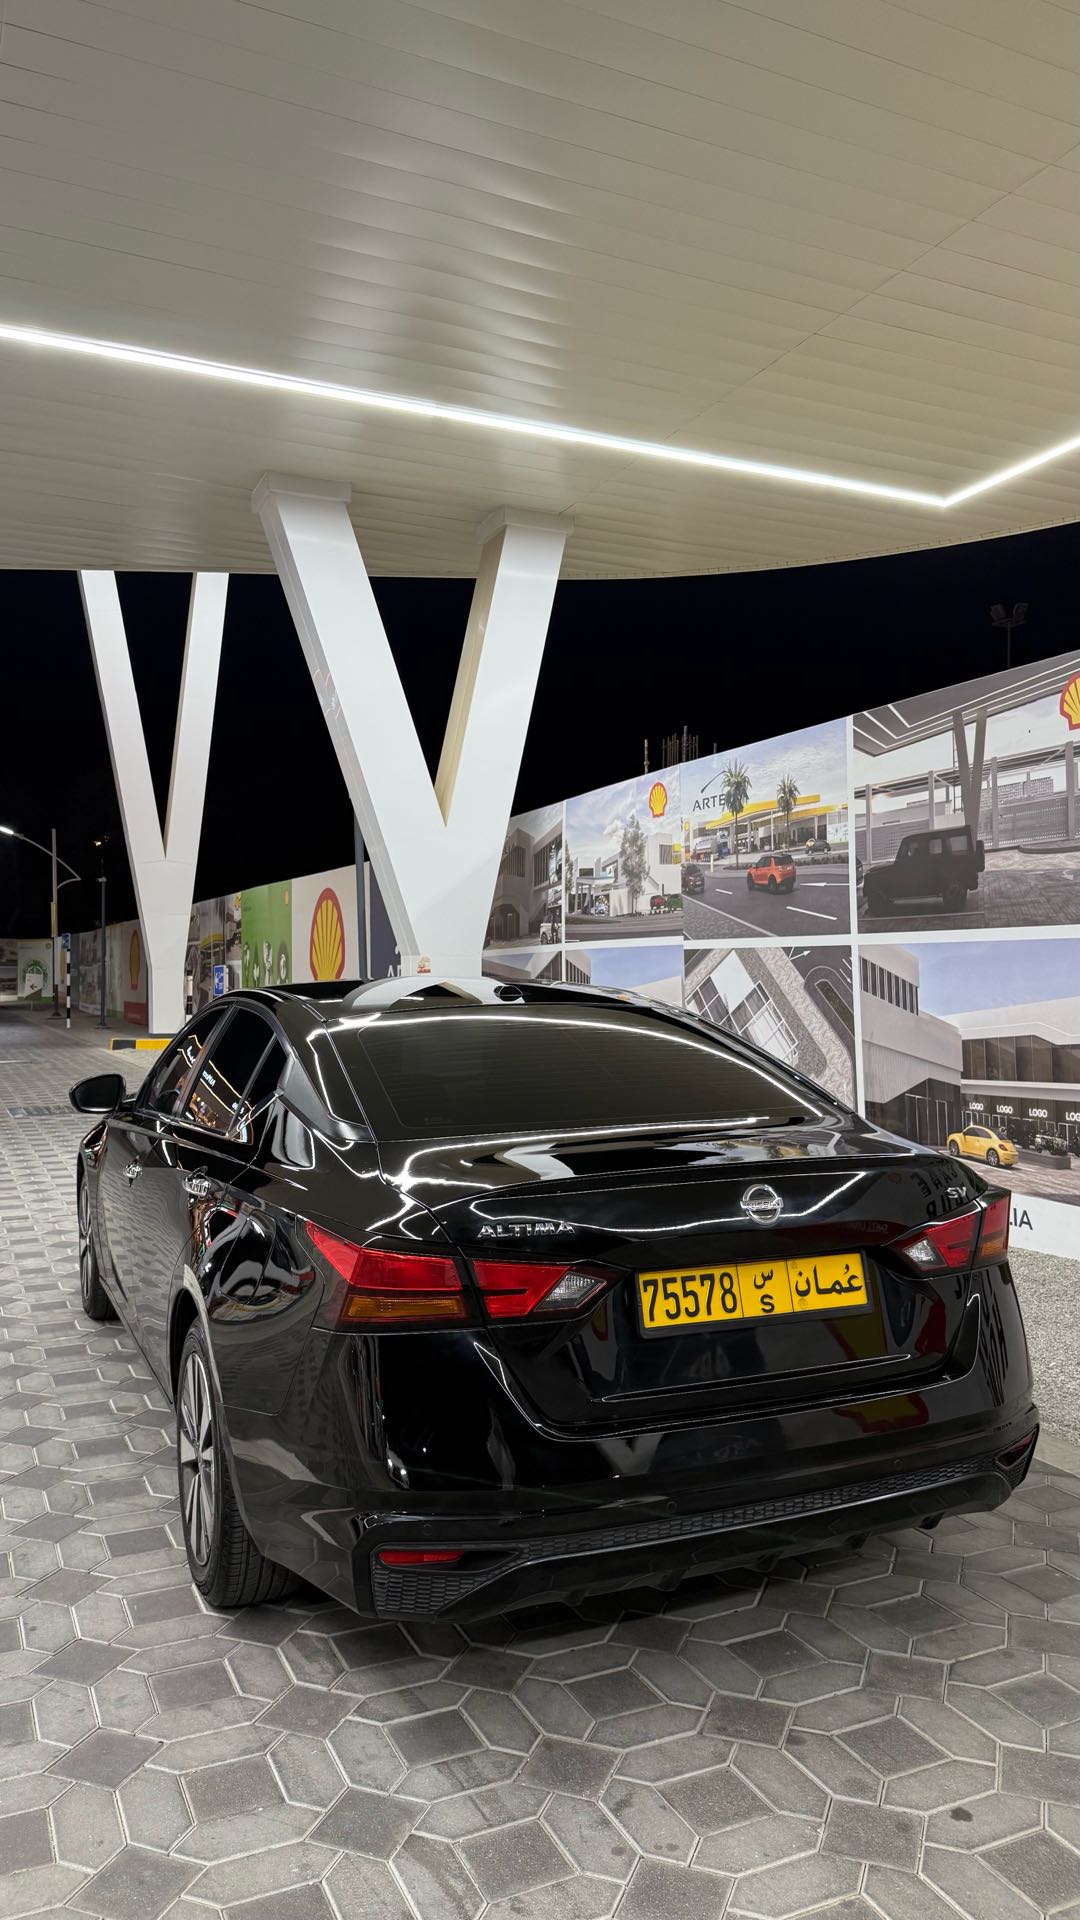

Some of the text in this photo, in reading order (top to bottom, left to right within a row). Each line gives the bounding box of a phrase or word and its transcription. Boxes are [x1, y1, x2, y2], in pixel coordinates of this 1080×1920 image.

[692, 793, 727, 812] ARTE
[969, 1101, 984, 1111] LOGO
[996, 1104, 1013, 1114] LOGO
[1028, 1108, 1048, 1118] LOGO
[1065, 1111, 1080, 1122] LOG
[946, 1186, 966, 1199] SV
[1009, 1207, 1033, 1231] IA
[477, 1220, 575, 1238] ALTIMA
[753, 1268, 773, 1290] س
[642, 1271, 738, 1322] 75578
[760, 1293, 775, 1314] S
